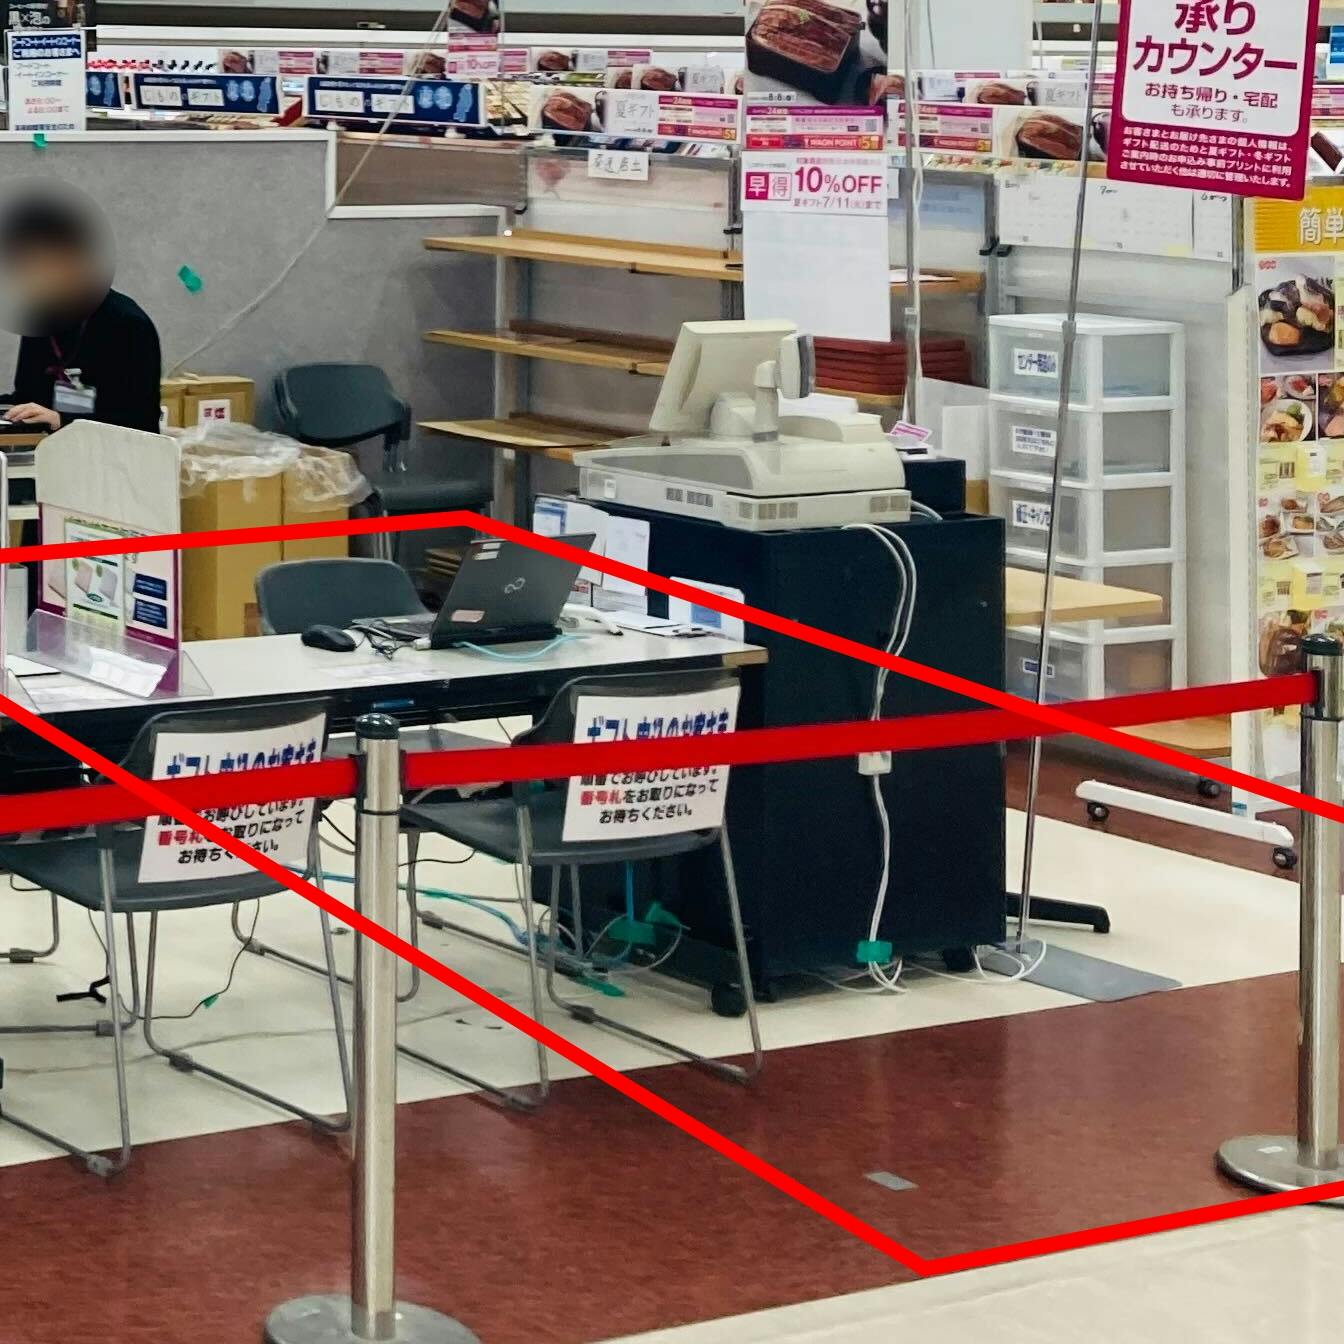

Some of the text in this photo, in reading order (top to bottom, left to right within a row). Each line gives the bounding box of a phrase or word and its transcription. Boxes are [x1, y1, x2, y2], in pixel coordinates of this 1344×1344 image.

[1132, 37, 1298, 81] カウンター
[1144, 82, 1279, 109] お持ち帰り・宅配
[1171, 104, 1249, 124] も承ります。
[794, 166, 883, 194] 10%OFF
[1299, 207, 1344, 246] 簡単
[580, 778, 719, 806] 番号札をお取りになって
[599, 803, 693, 824] お待ちください。
